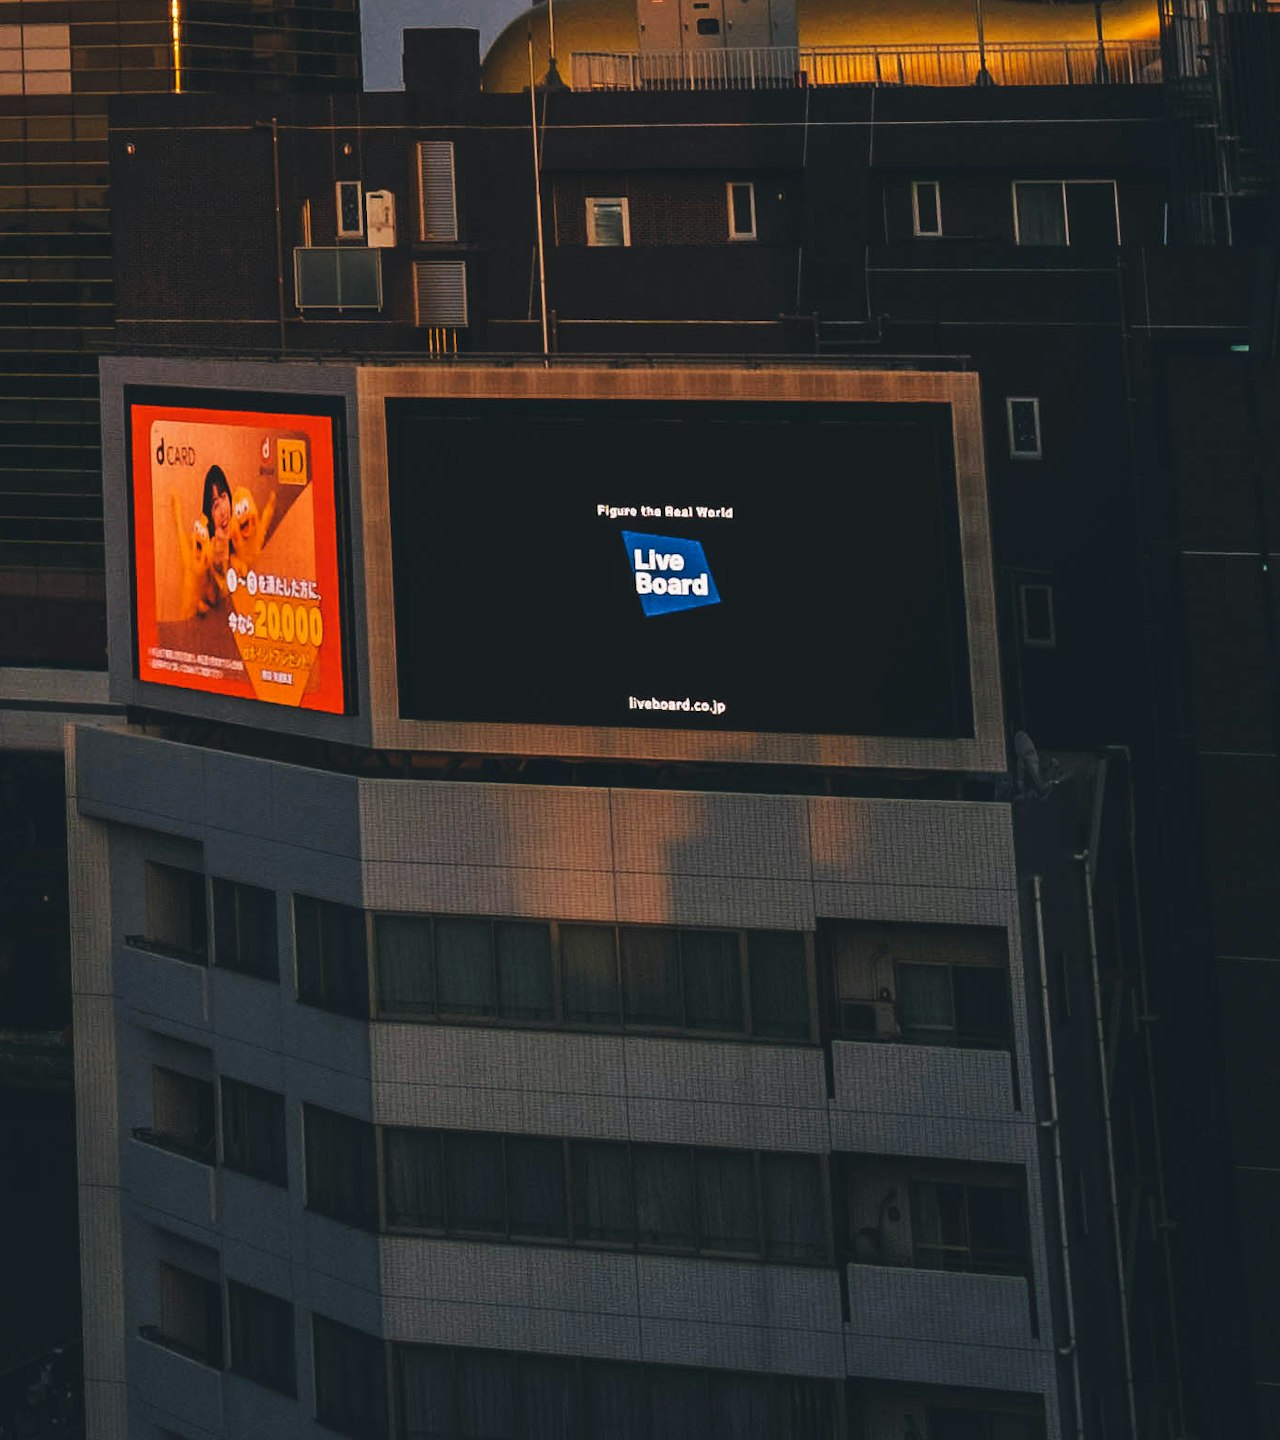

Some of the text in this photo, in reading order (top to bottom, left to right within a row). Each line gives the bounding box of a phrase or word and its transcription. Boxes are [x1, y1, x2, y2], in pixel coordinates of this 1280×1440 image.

[166, 445, 196, 467] CARD
[596, 504, 734, 519] Figure the Real World
[634, 548, 685, 572] Live
[635, 571, 709, 597] Board
[628, 695, 727, 715] liveboard.co.jp
